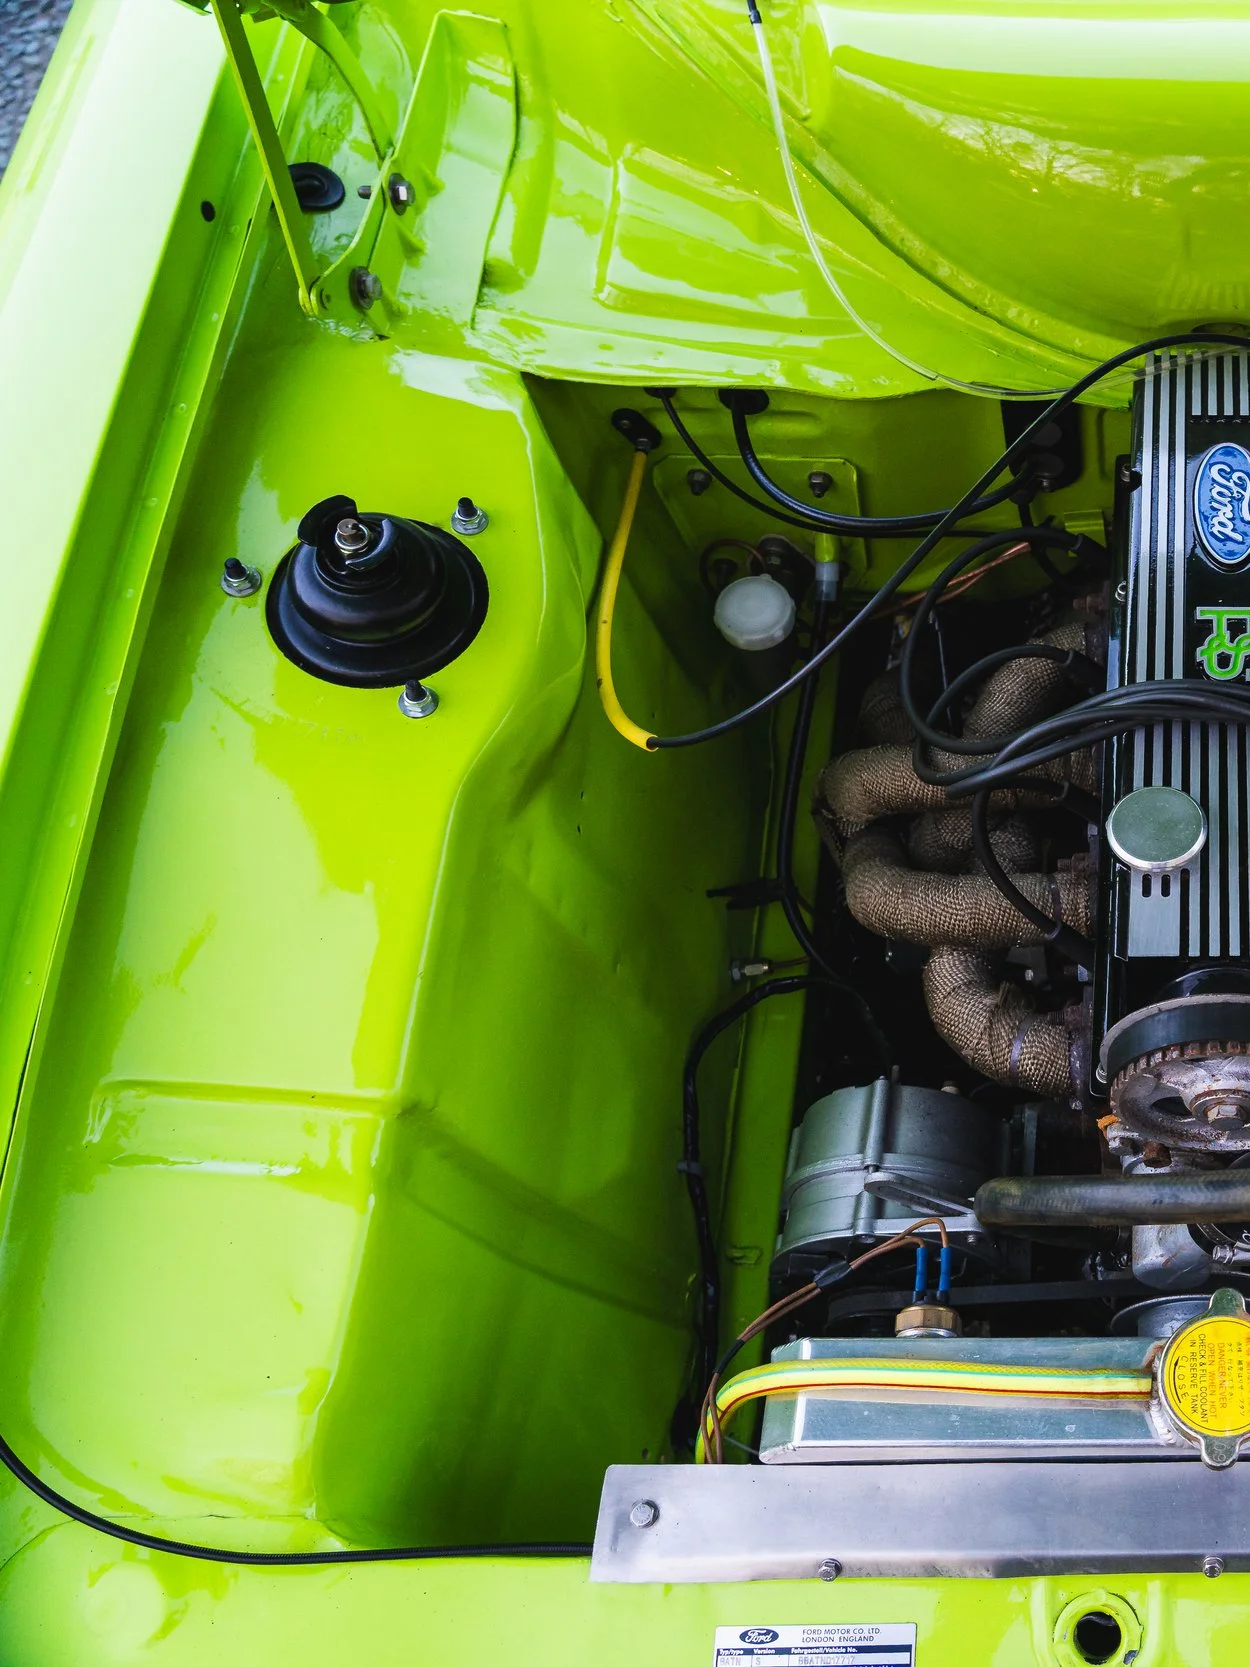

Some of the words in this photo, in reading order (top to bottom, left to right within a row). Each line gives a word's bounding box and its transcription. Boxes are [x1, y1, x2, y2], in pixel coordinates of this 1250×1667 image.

[1189, 1339, 1197, 1348] IN
[1198, 1333, 1206, 1360] CHECK
[1207, 1343, 1215, 1366] OPEN
[1177, 1355, 1190, 1400] CLOSE
[1189, 1351, 1198, 1389] RESERVE
[1199, 1368, 1207, 1385] FILL
[1208, 1371, 1217, 1396] WHEN
[1190, 1393, 1199, 1415] TANK
[1200, 1386, 1209, 1424] COOLANT
[1209, 1400, 1217, 1419] HOT
[745, 1629, 774, 1643] Ford
[838, 1635, 875, 1643] ENGLAND
